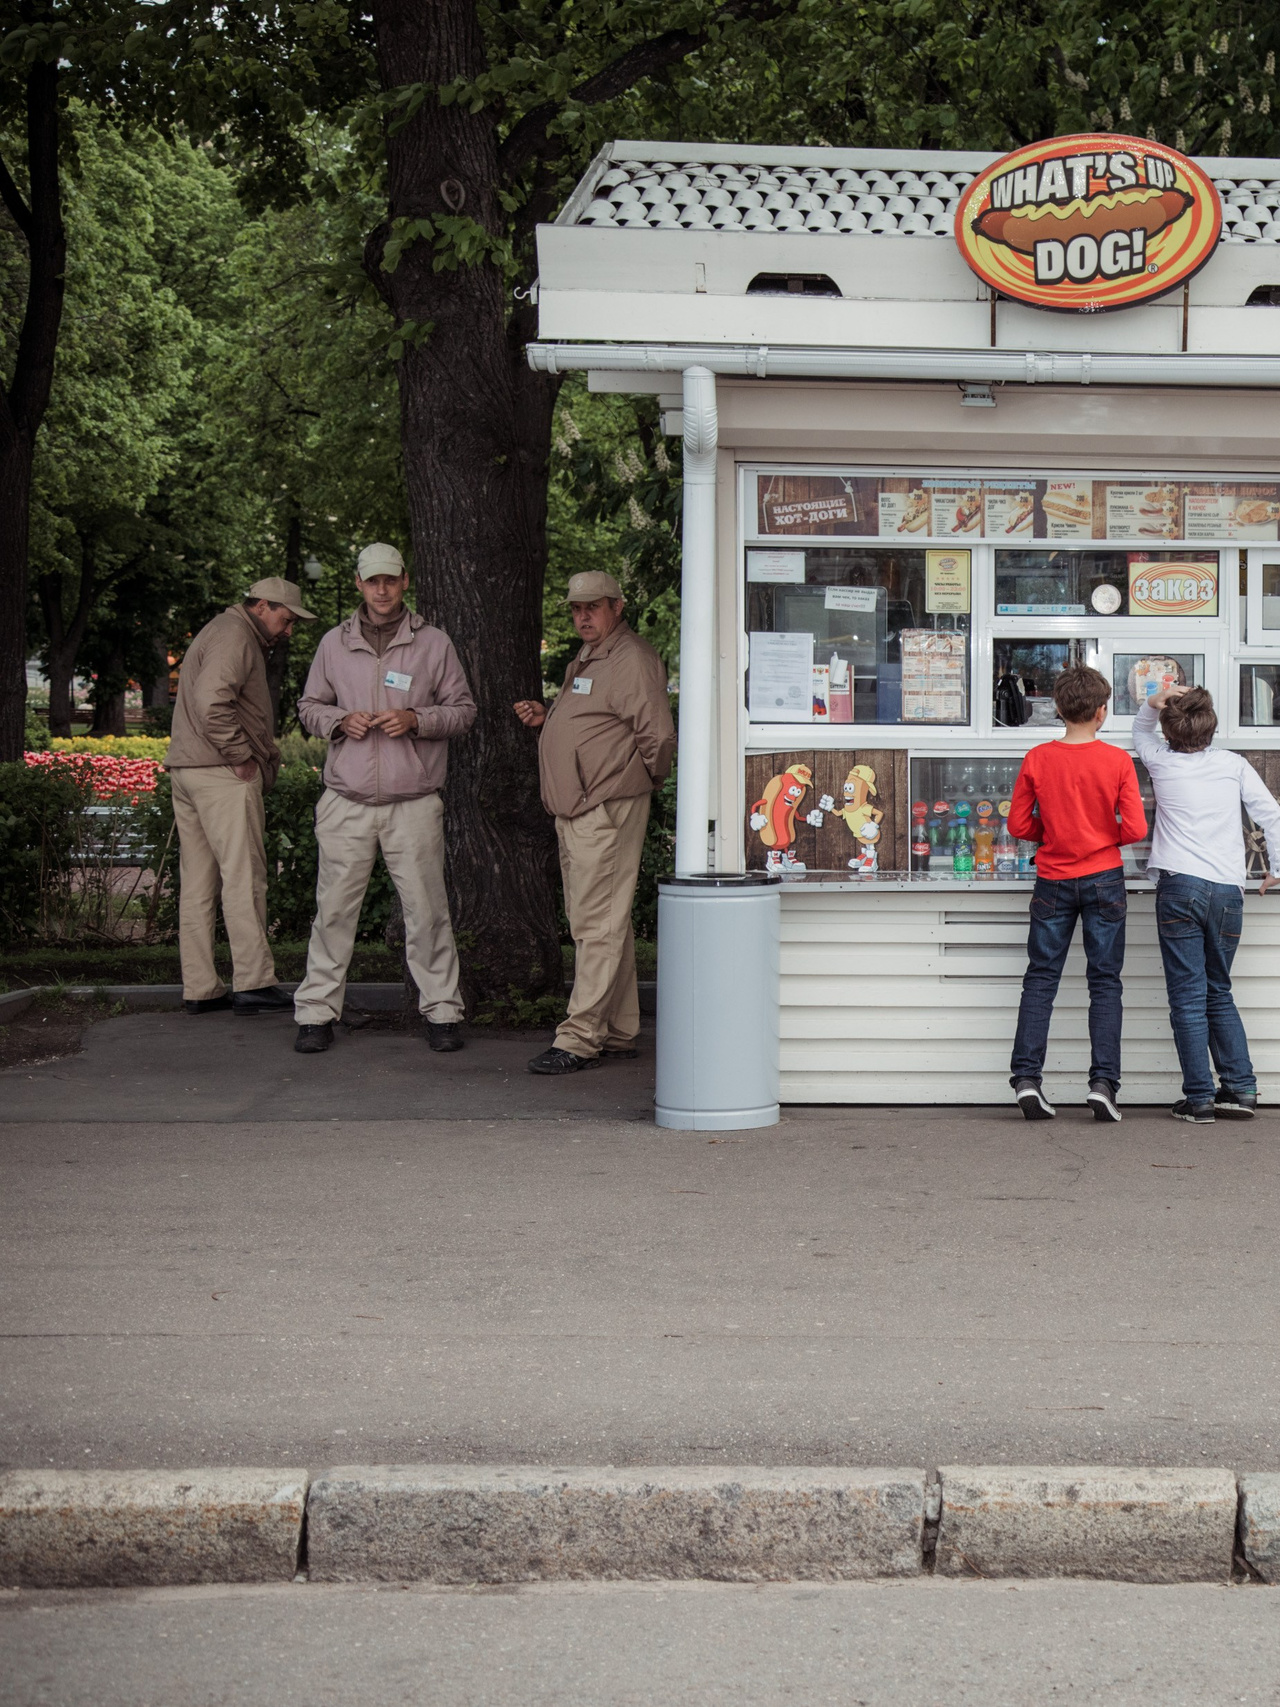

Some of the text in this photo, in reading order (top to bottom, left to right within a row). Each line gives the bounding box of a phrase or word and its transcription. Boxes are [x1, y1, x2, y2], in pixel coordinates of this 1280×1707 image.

[992, 152, 1175, 208] WHAT'S UP
[1036, 229, 1145, 281] DOG!
[772, 498, 847, 514] НАСТОЯЩИЕ
[774, 507, 848, 526] ХОТ-ДОГИ
